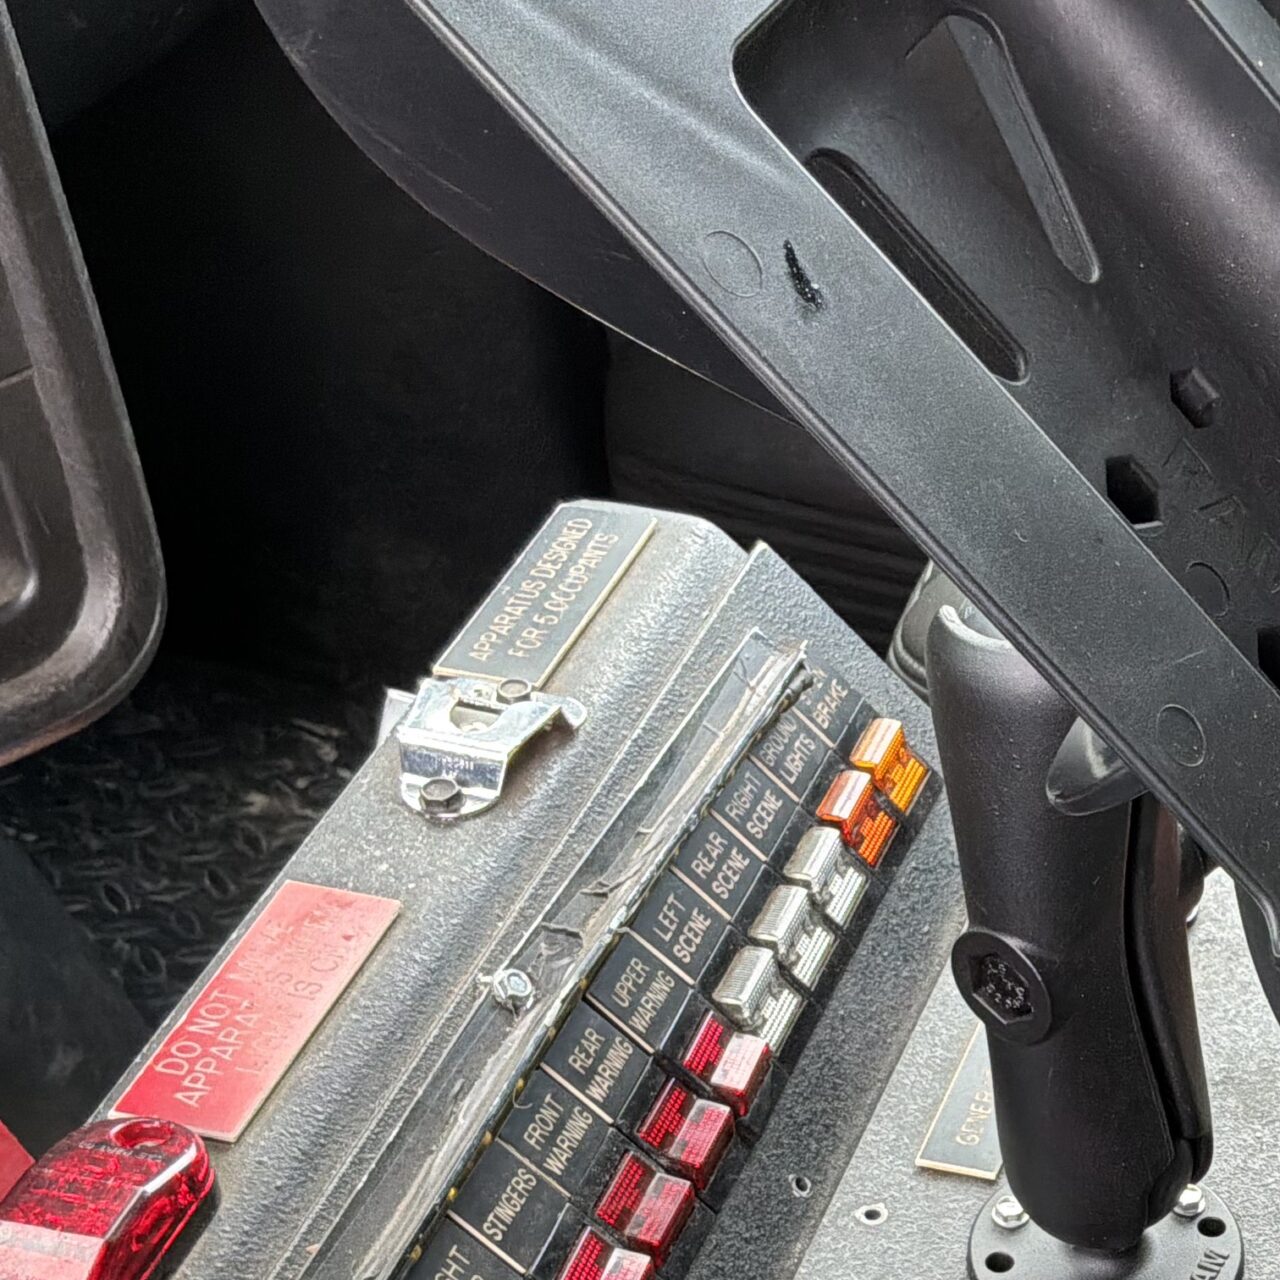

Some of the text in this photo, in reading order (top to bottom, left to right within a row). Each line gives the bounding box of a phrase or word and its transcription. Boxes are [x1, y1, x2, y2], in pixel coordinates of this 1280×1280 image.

[469, 517, 593, 661] APPARATUS DESIGNED
[508, 533, 619, 659] FOR 5 OCCUPANTS
[811, 678, 848, 730] BRAKE
[760, 713, 797, 767] GROUND
[779, 732, 816, 785] LIGHTS
[725, 772, 761, 822] RIGHT
[746, 788, 783, 839] SCENE
[690, 831, 728, 879] REAR
[711, 846, 750, 900] SCENE
[652, 893, 686, 942] LEFT
[673, 907, 711, 964] SCENE
[611, 957, 649, 1008] UPPER
[629, 970, 675, 1034] WARNING
[155, 1041, 202, 1076] DO
[186, 990, 234, 1036] NOT
[568, 1027, 605, 1075] REAR
[585, 1036, 633, 1103] WARNING
[523, 1093, 564, 1150] FRONT
[543, 1106, 593, 1176] WARNING
[482, 1168, 537, 1242] STINGERS
